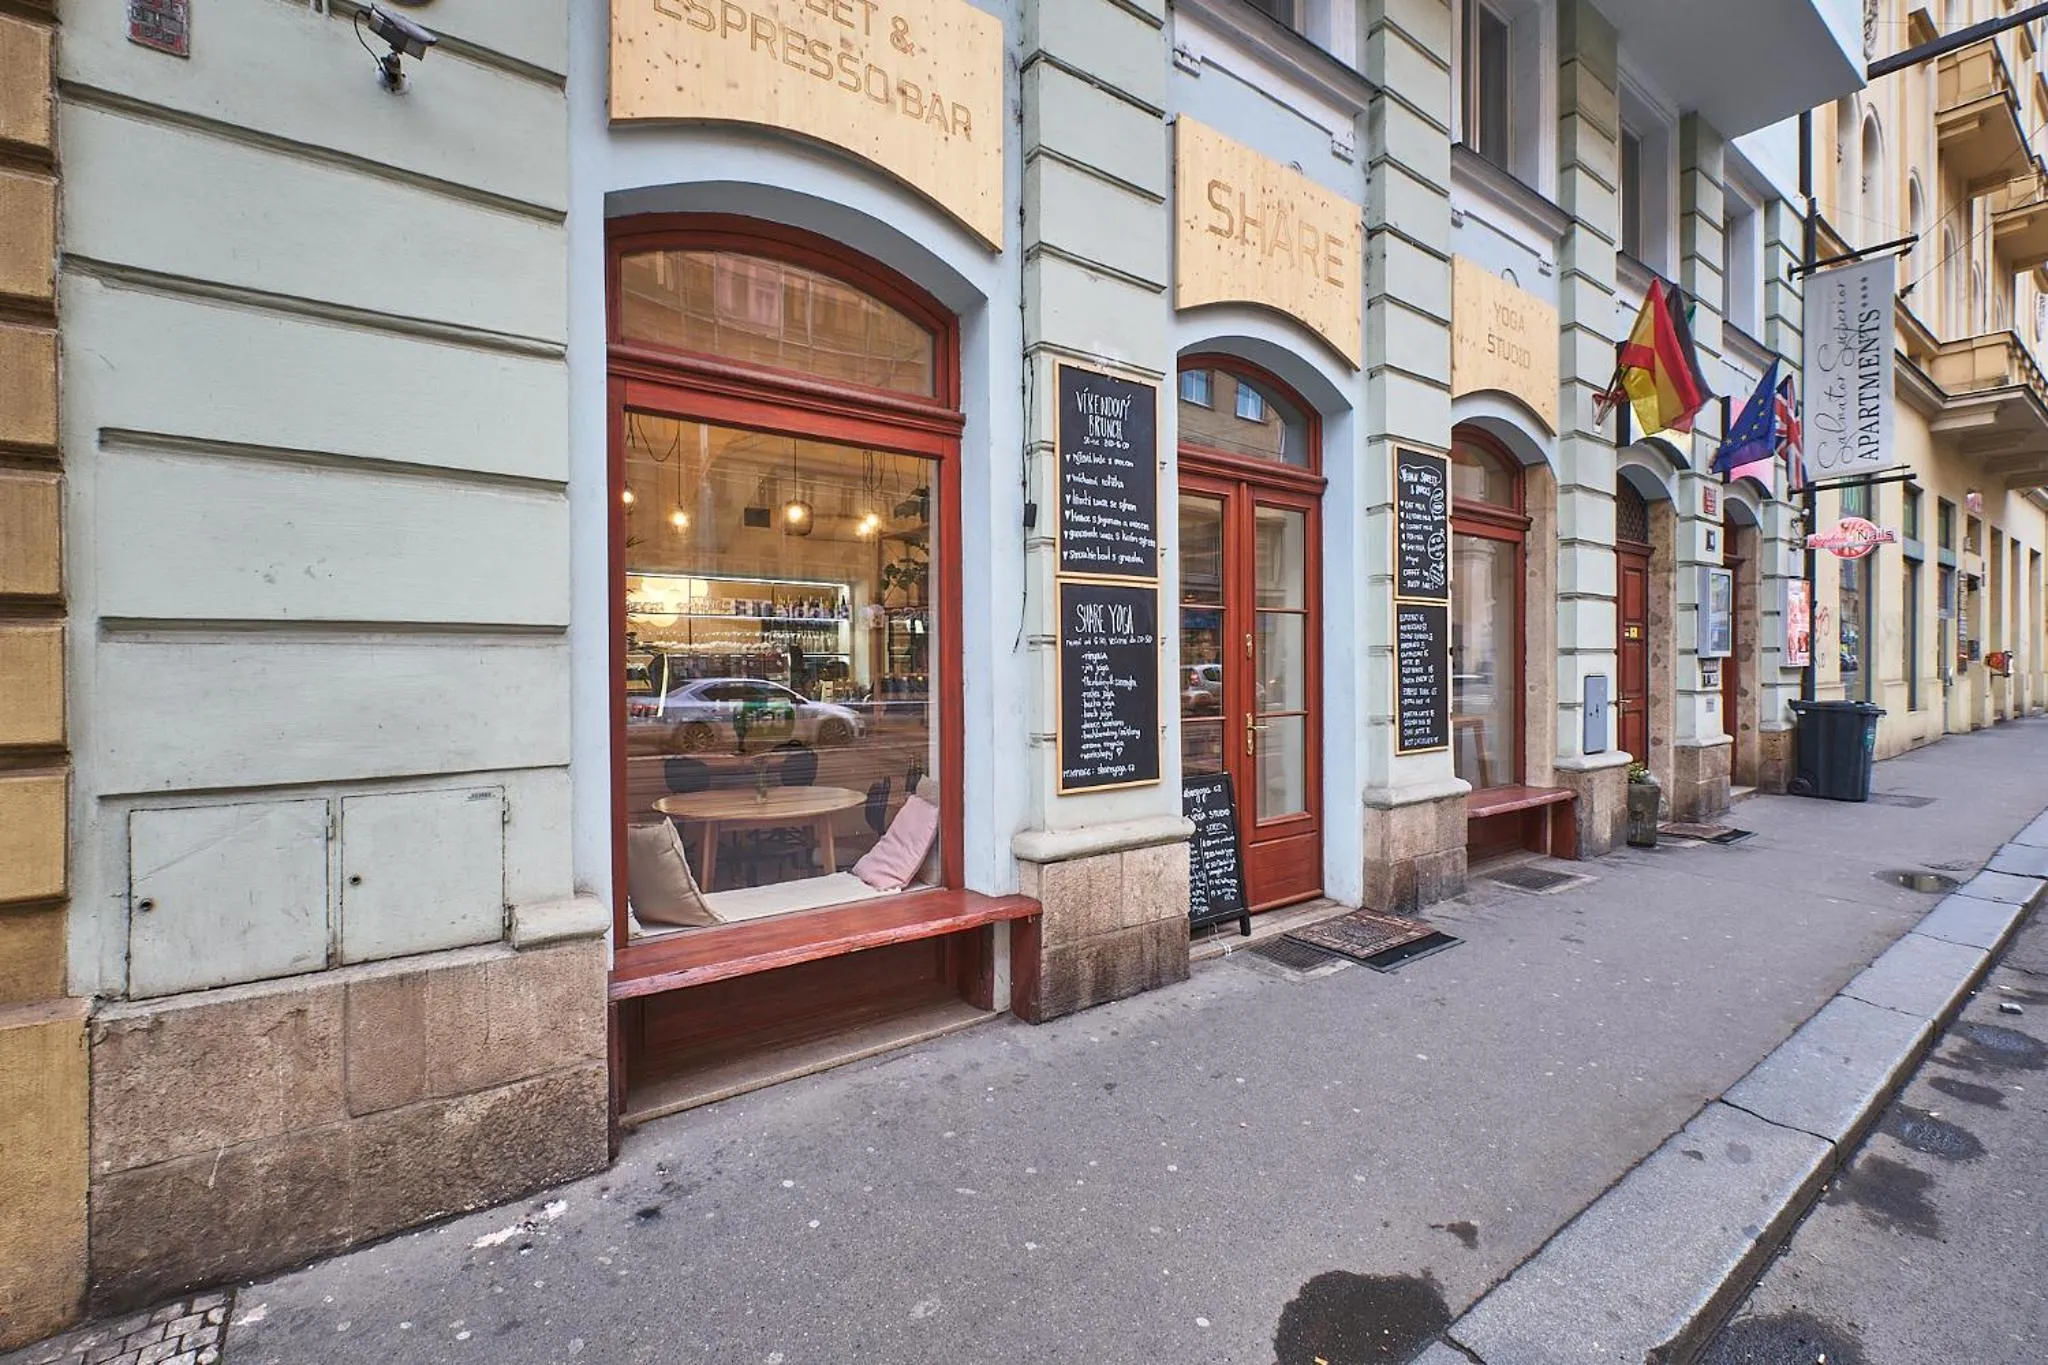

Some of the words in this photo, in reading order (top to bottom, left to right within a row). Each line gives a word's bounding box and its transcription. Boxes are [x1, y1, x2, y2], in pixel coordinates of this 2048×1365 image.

[890, 15, 914, 57] &
[900, 78, 973, 143] BAR
[1207, 178, 1345, 289] SHARE
[1493, 302, 1526, 336] YOGA
[1487, 333, 1531, 370] STUDIO
[1858, 309, 1881, 461] APARTMENTS
[1088, 414, 1123, 441] BRUNCH
[1857, 528, 1895, 541] Nails
[1075, 604, 1106, 634] SHARE
[1108, 604, 1134, 635] YOGA
